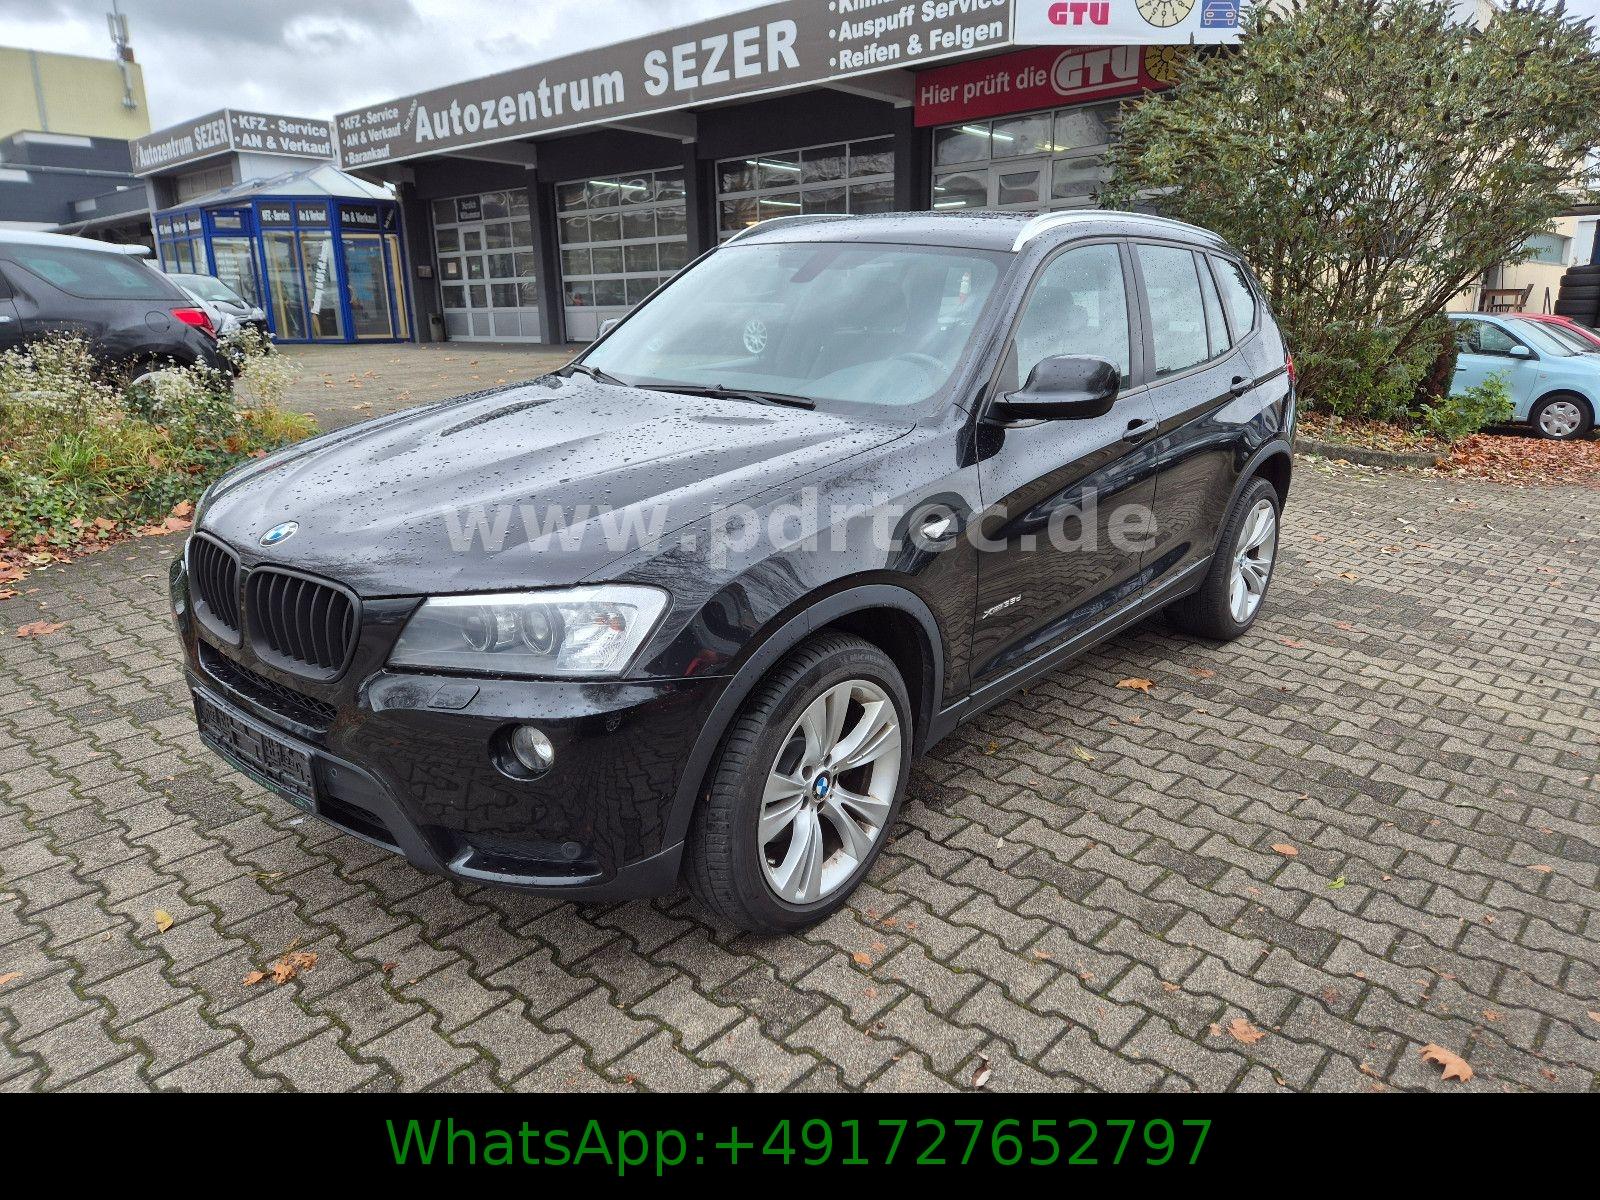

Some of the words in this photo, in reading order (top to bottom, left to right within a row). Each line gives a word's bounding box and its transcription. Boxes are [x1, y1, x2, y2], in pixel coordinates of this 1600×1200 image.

[839, 4, 916, 42] Auspuff
[839, 43, 900, 70] Reifen
[907, 34, 923, 55] &
[929, 20, 1003, 50] Felgen
[415, 71, 625, 143] Autozentrum
[643, 19, 801, 96] SEZER
[921, 84, 958, 106] Hier
[963, 73, 1010, 104] prüft
[1015, 65, 1047, 90] die
[239, 115, 268, 131] KFZ
[278, 119, 328, 137] Service
[344, 114, 361, 130] KFZ
[366, 110, 399, 125] Service
[347, 133, 359, 147] AN
[361, 130, 367, 144] &
[368, 122, 401, 142] Verkauf
[139, 135, 194, 167] Autozentrum
[194, 118, 228, 150] SEZER
[242, 133, 263, 148] AN
[266, 135, 277, 149] &
[279, 136, 331, 154] Verkauf
